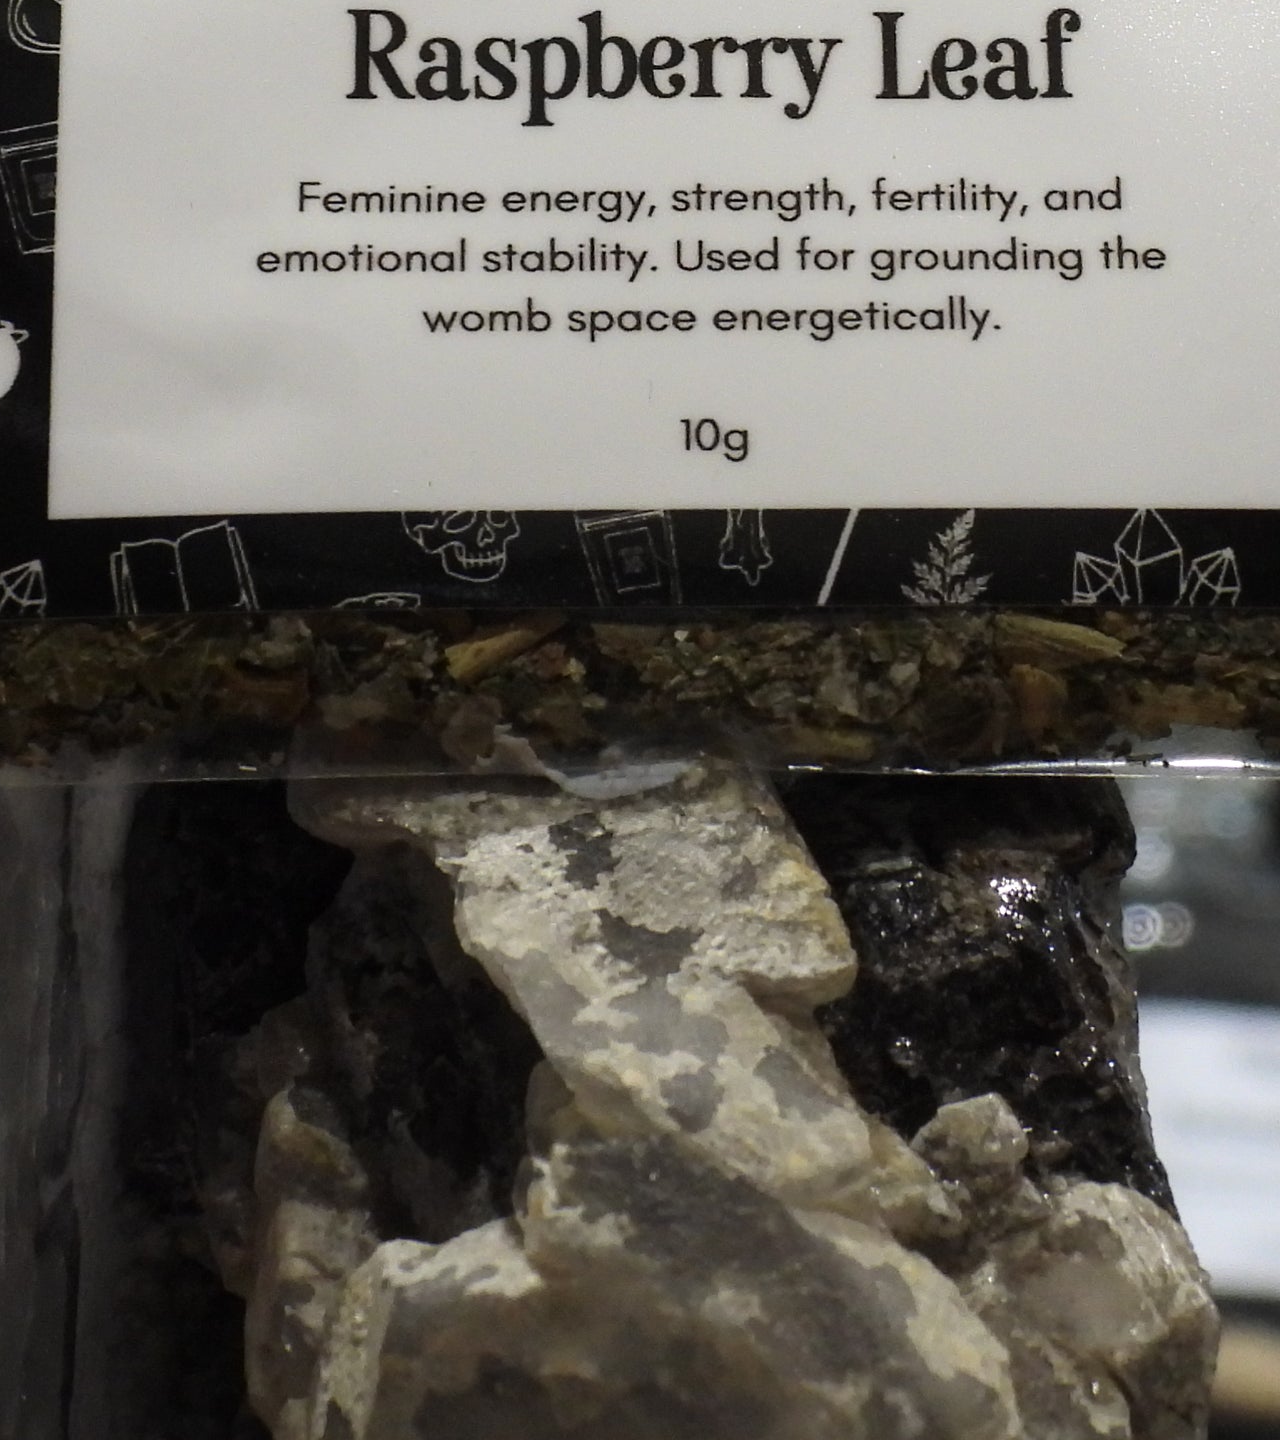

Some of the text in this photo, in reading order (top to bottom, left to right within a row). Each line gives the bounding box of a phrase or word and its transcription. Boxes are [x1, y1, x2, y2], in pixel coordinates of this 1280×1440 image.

[346, 8, 1081, 126] Raspberry Leaf
[298, 175, 1123, 224] Feminine energy, strength, fertility, and
[256, 234, 1167, 283] emotional stability. Used for grounding the
[422, 295, 1002, 343] womb space energetically.
[679, 418, 749, 464] 10g
